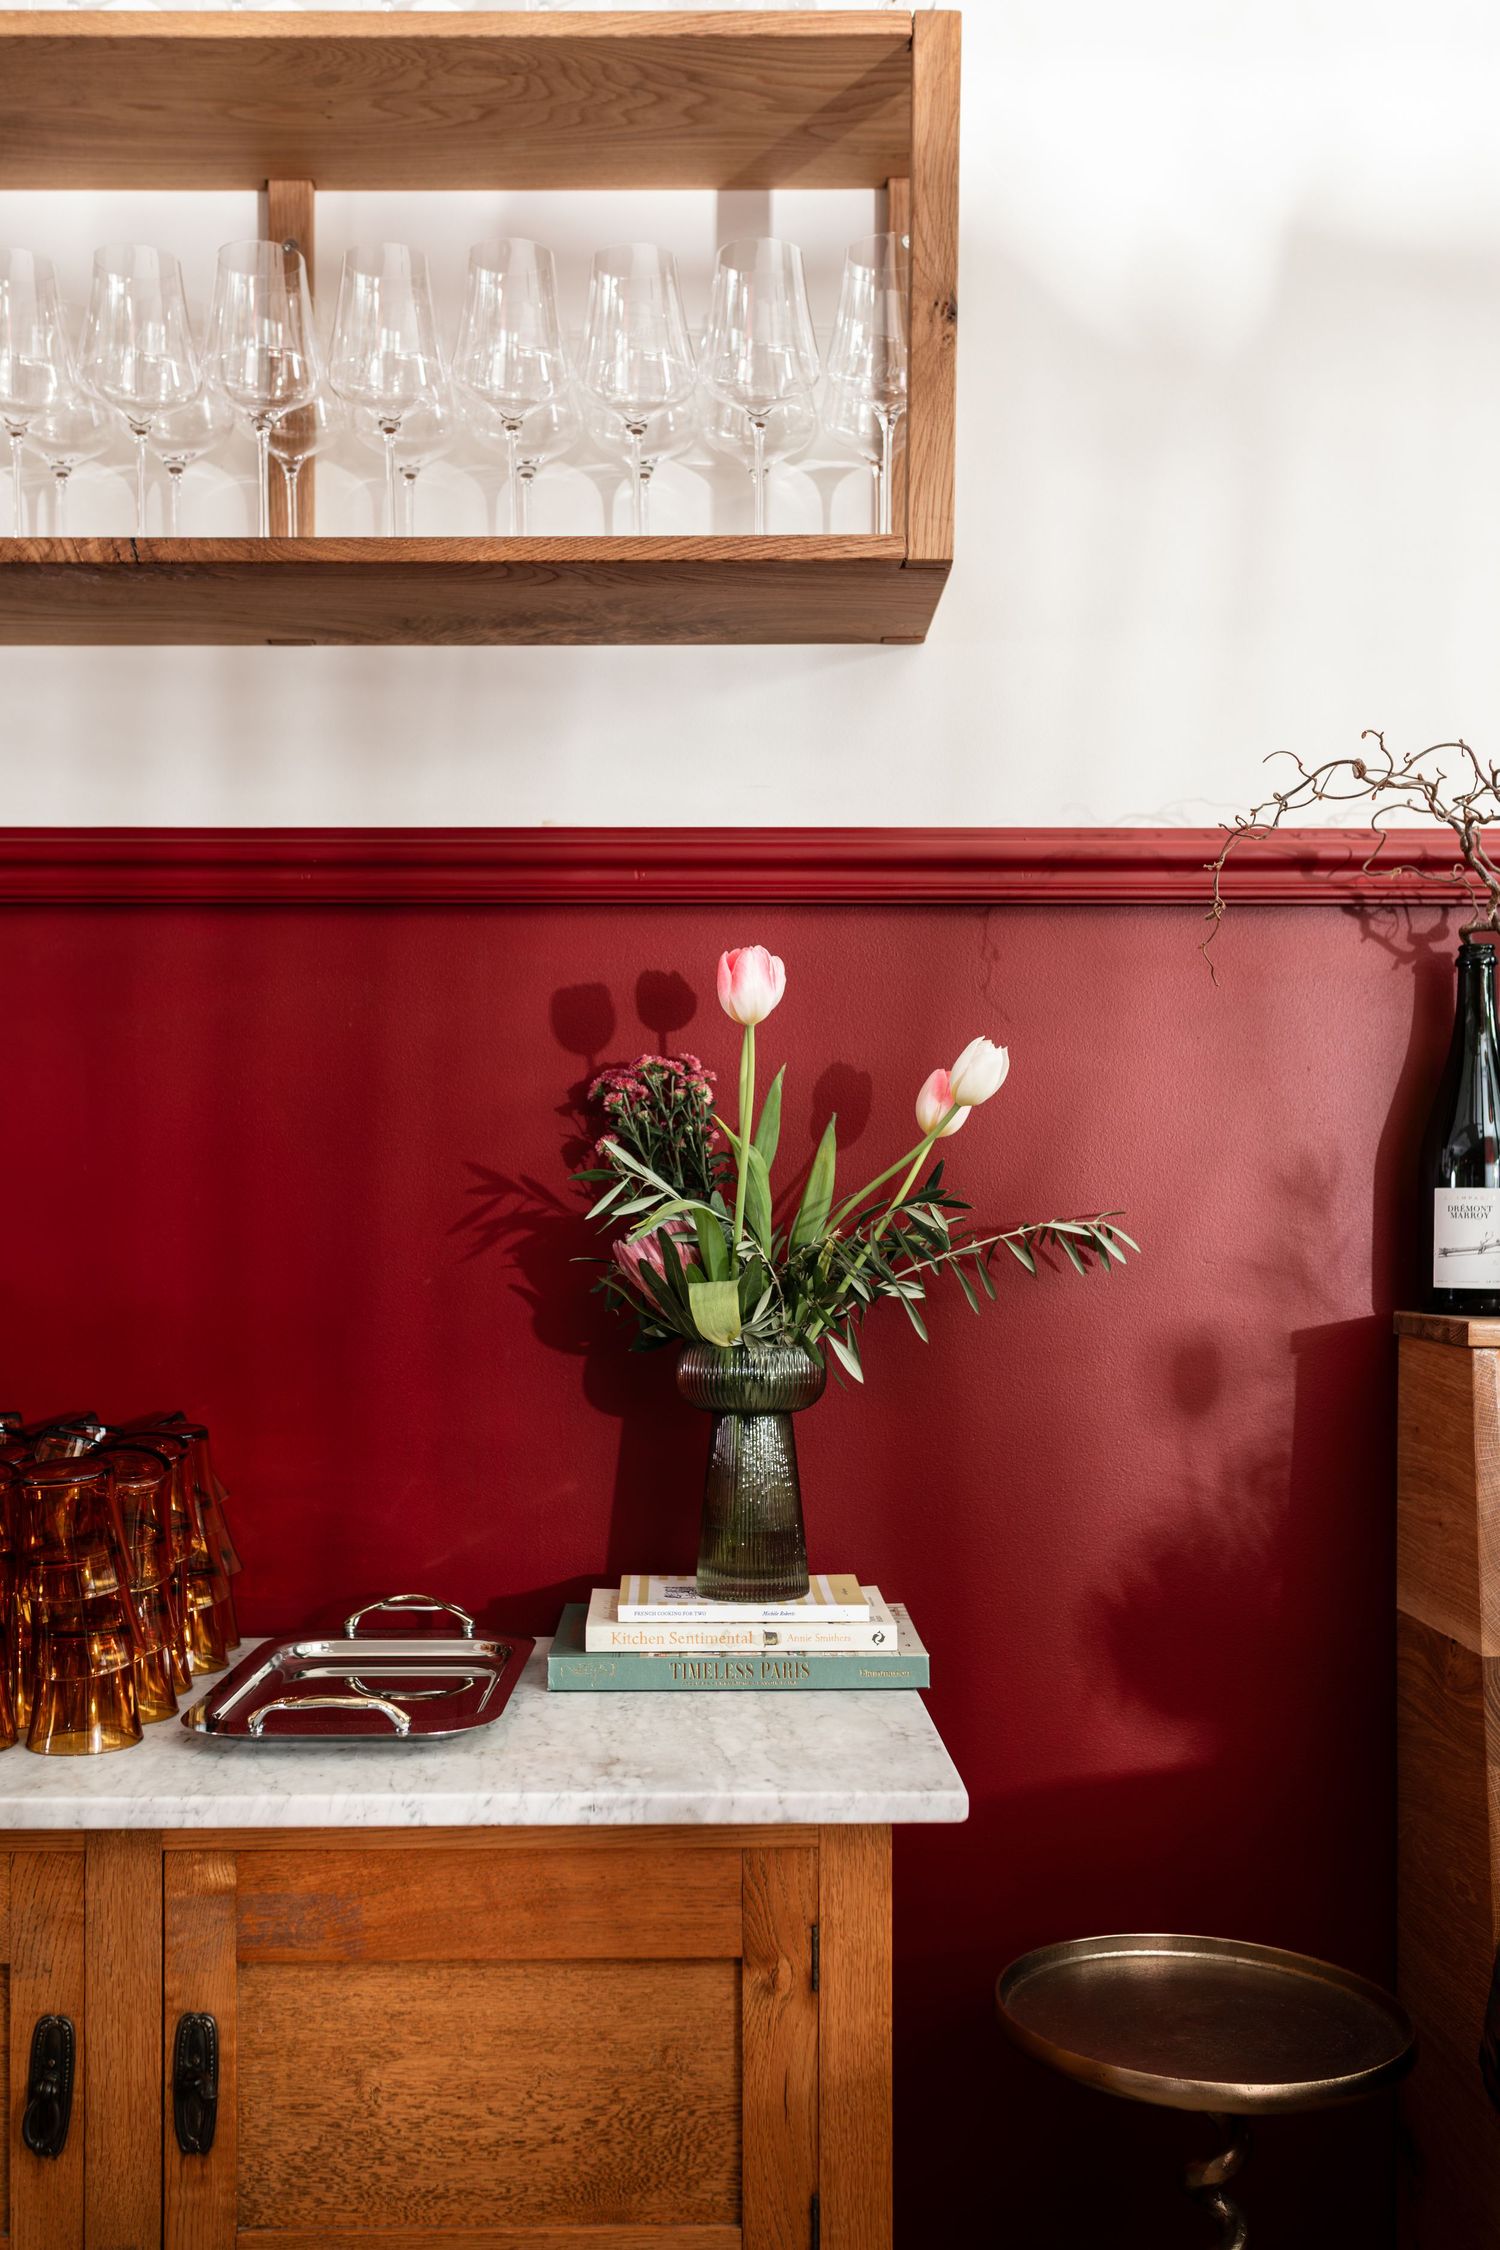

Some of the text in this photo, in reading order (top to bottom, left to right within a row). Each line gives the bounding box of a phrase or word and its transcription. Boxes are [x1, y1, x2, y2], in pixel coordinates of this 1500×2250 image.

[1447, 1204, 1493, 1212] DRÉMONT
[611, 1631, 753, 1645] Kitchen Sentimental
[787, 1633, 851, 1643] Annie Smithers
[669, 1661, 810, 1680] TIMELESS PARIS
